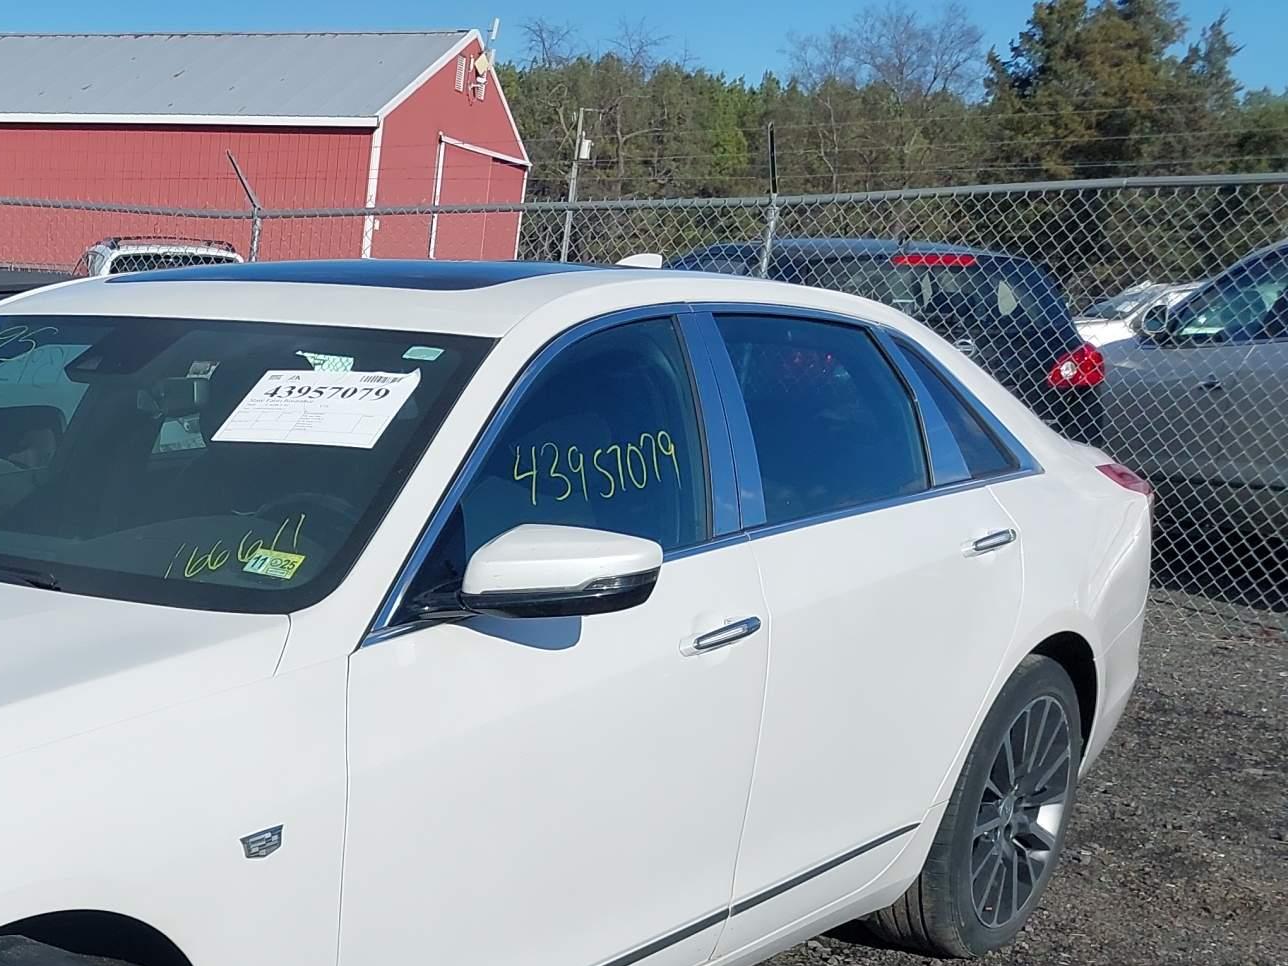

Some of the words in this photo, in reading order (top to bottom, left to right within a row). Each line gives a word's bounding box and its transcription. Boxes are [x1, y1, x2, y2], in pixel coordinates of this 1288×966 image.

[263, 384, 391, 401] 43957079
[513, 430, 683, 506] 43957079
[251, 554, 270, 570] 11
[279, 558, 298, 571] 25
